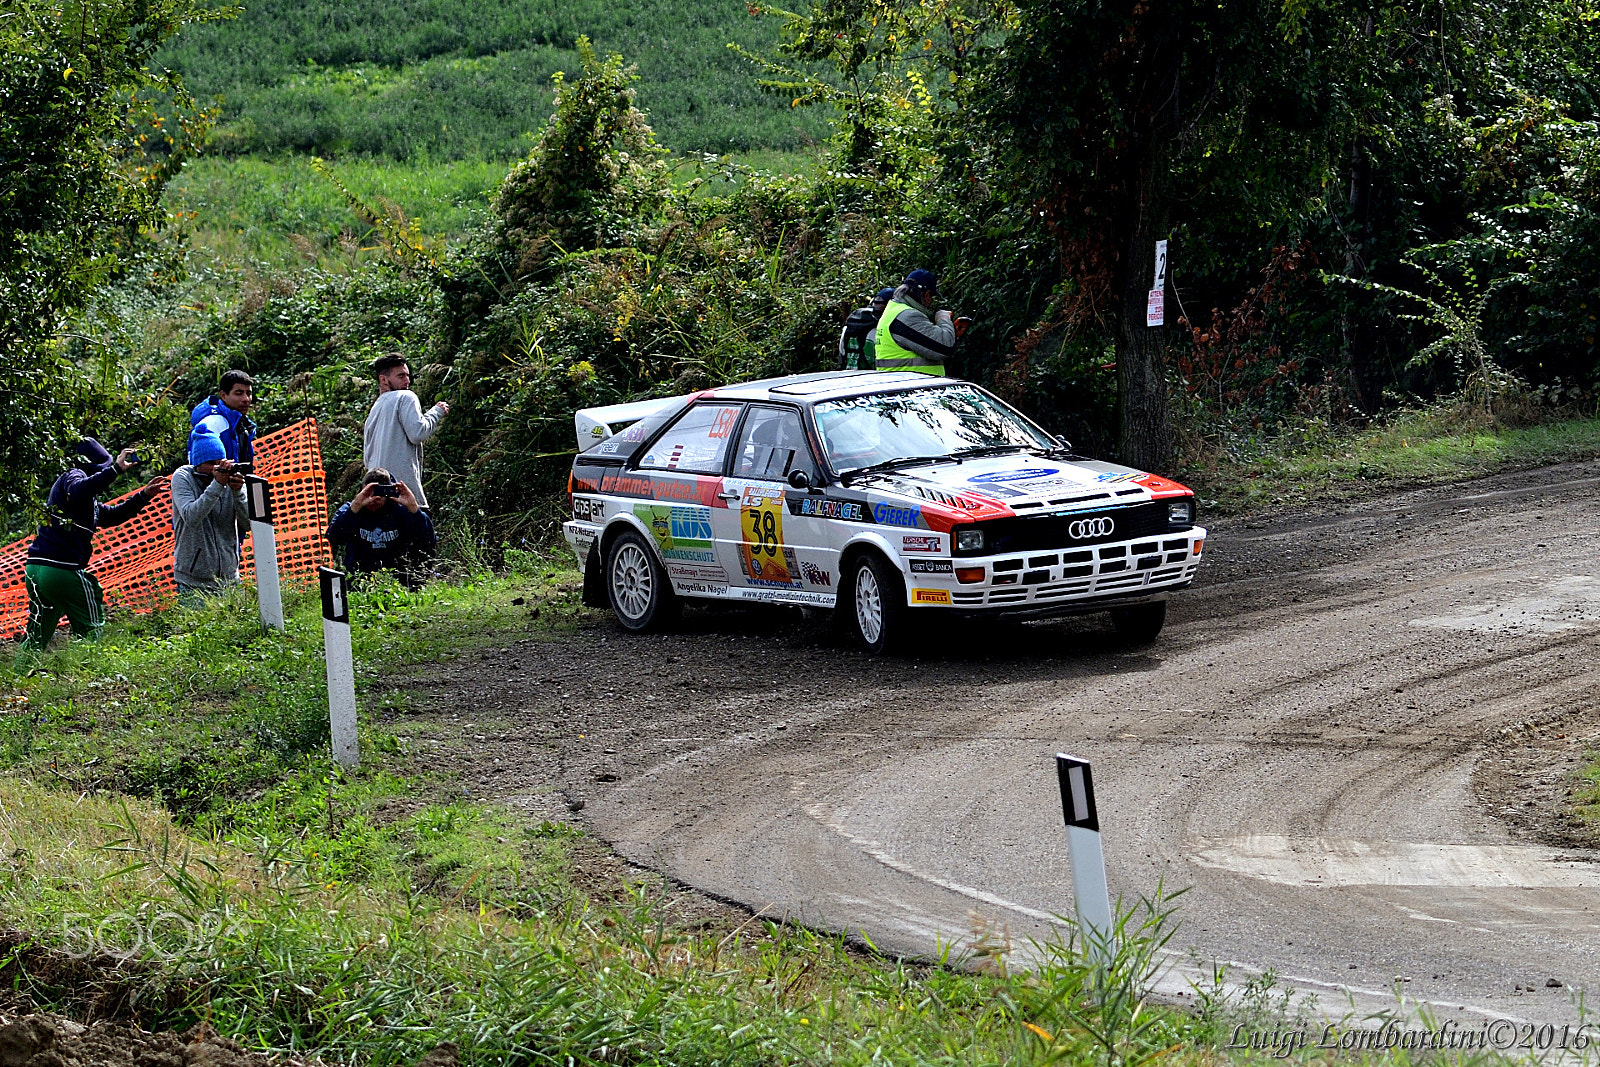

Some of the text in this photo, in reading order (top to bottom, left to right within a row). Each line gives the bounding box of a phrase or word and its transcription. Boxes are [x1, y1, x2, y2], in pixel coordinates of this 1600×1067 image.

[742, 496, 763, 507] LS
[749, 509, 779, 557] 38
[676, 581, 728, 596] Angelika Nagel
[916, 590, 948, 602] PIRELLI
